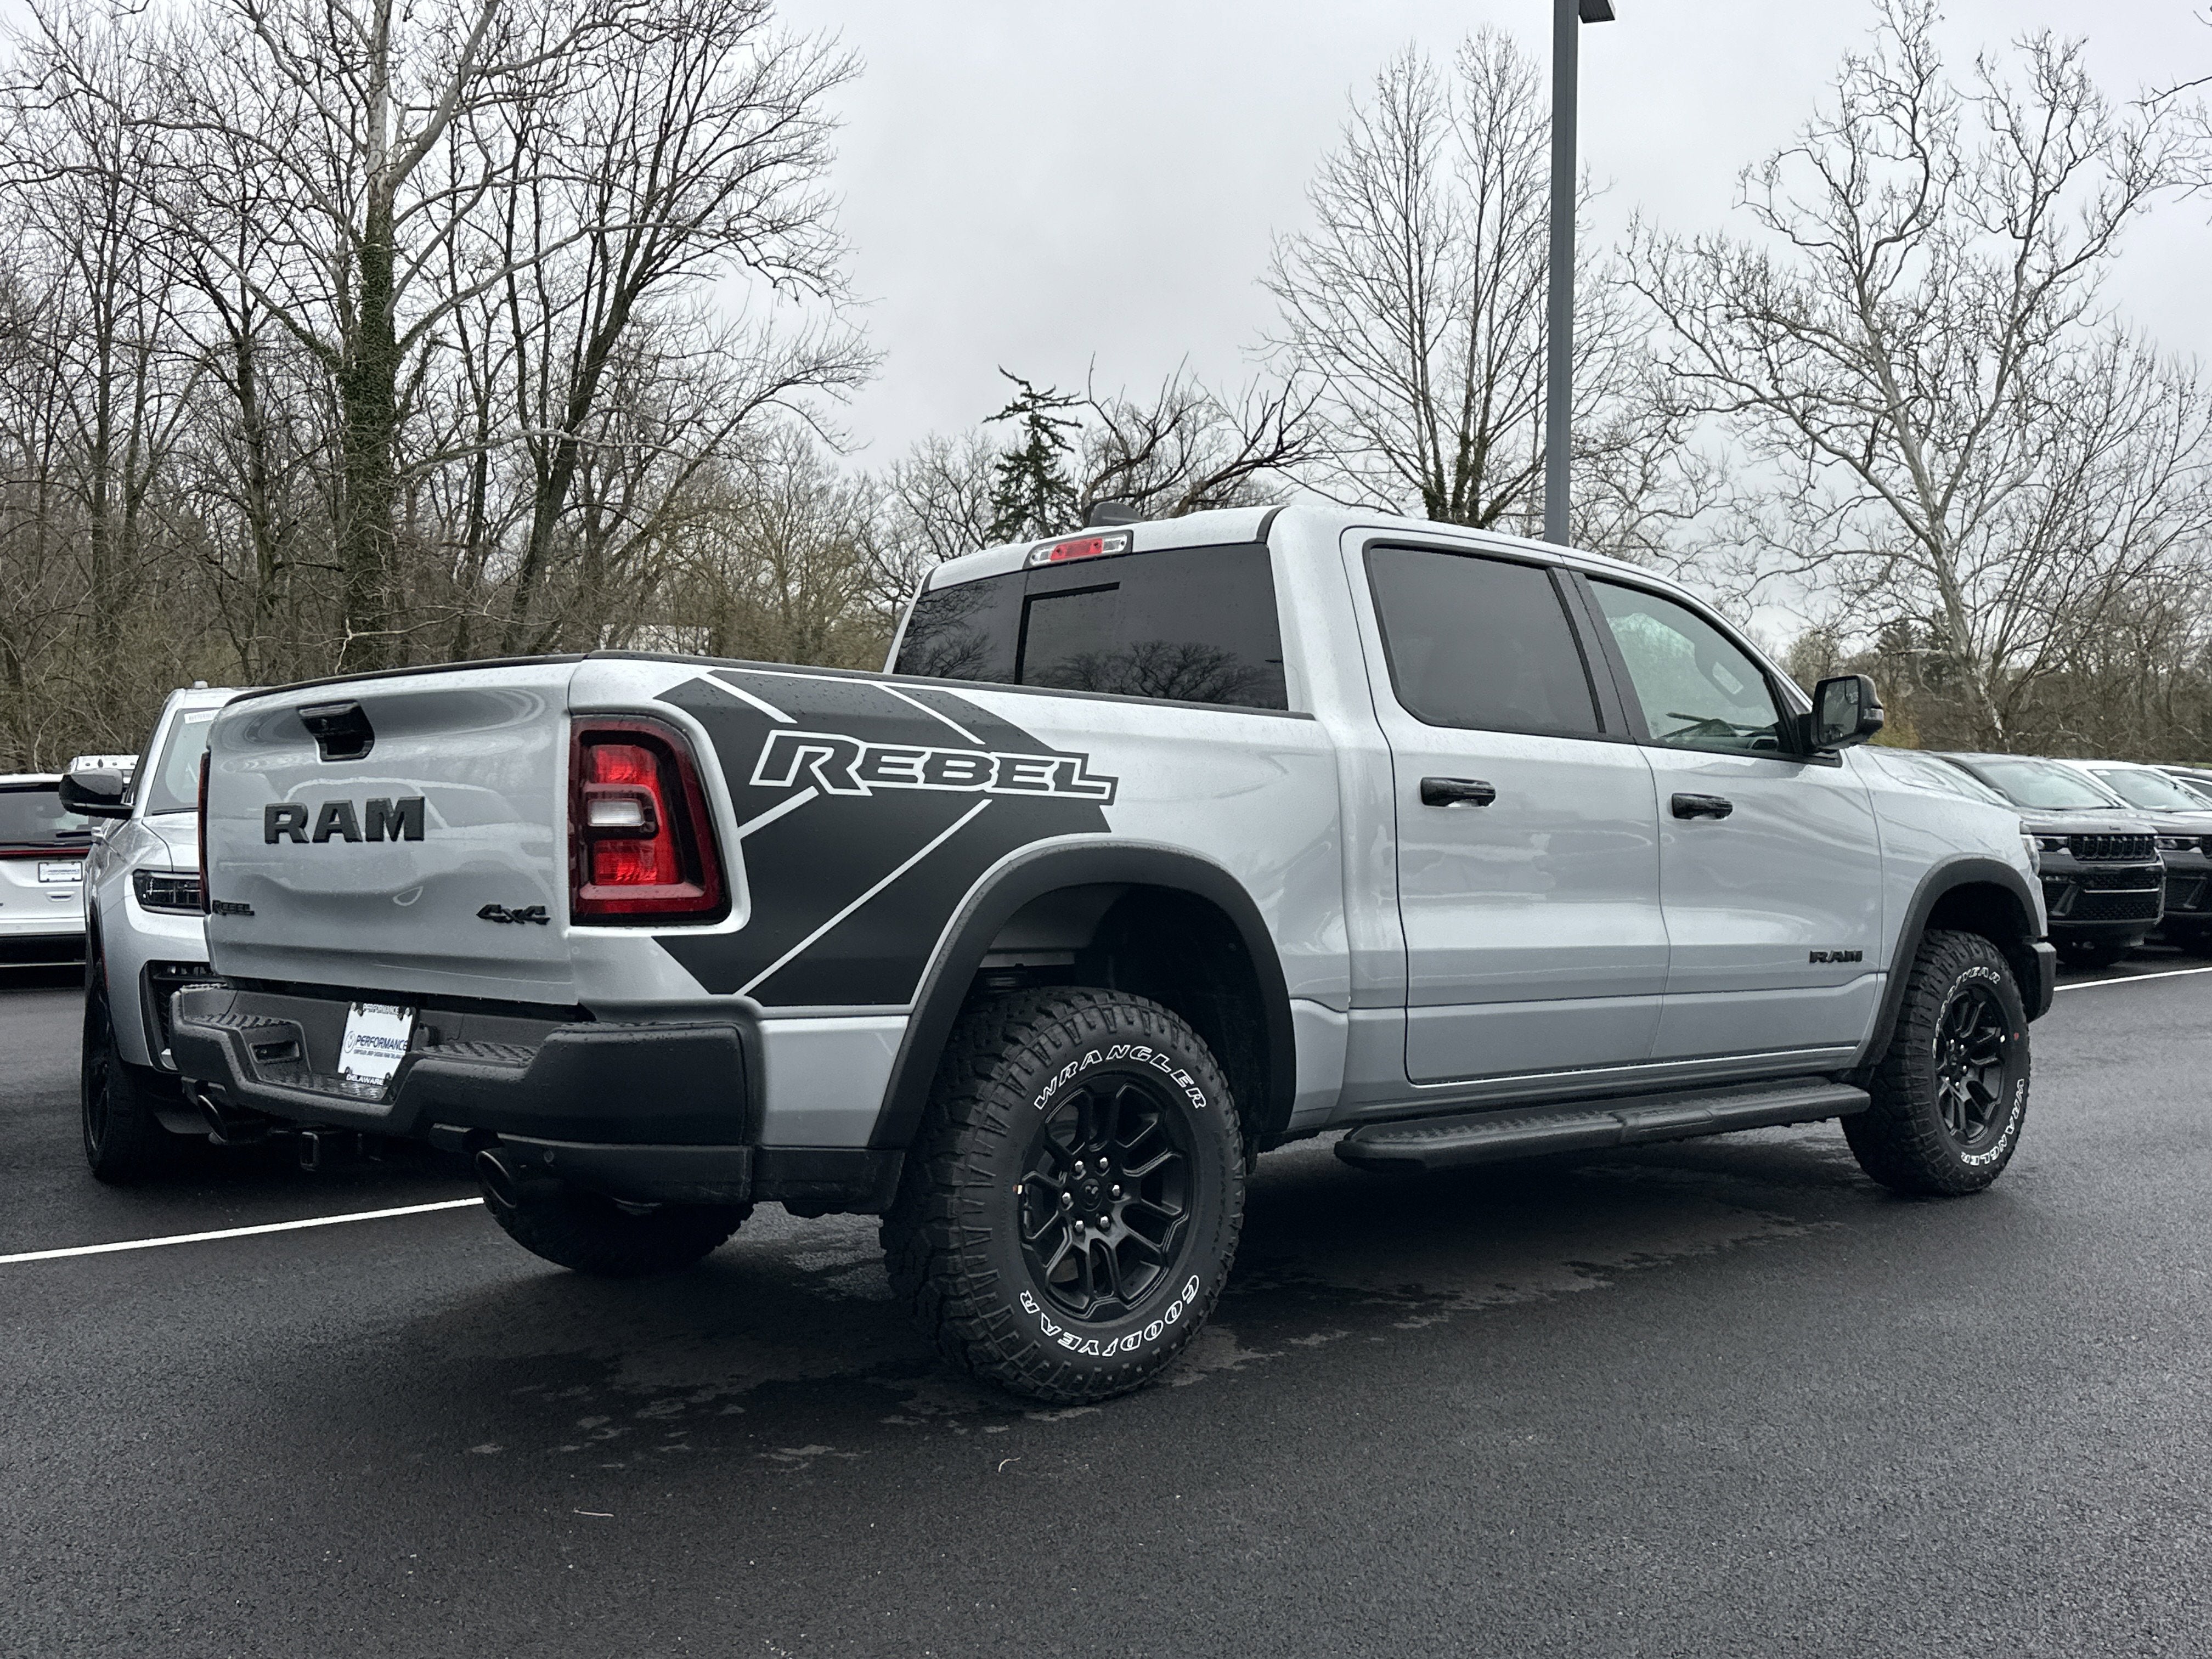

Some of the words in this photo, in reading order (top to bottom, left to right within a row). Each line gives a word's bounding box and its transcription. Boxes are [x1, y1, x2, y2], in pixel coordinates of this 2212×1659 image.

[749, 729, 1113, 799] REBEL
[264, 796, 425, 844] RAM
[1809, 950, 1863, 963] RAM
[356, 1035, 408, 1051] PERFORMANCE
[346, 1074, 383, 1085] DELAWARE
[1034, 1044, 1206, 1110] WRANGLER
[1961, 1078, 2025, 1166] WRANGLER
[1020, 1274, 1200, 1357] GOODYEAR
